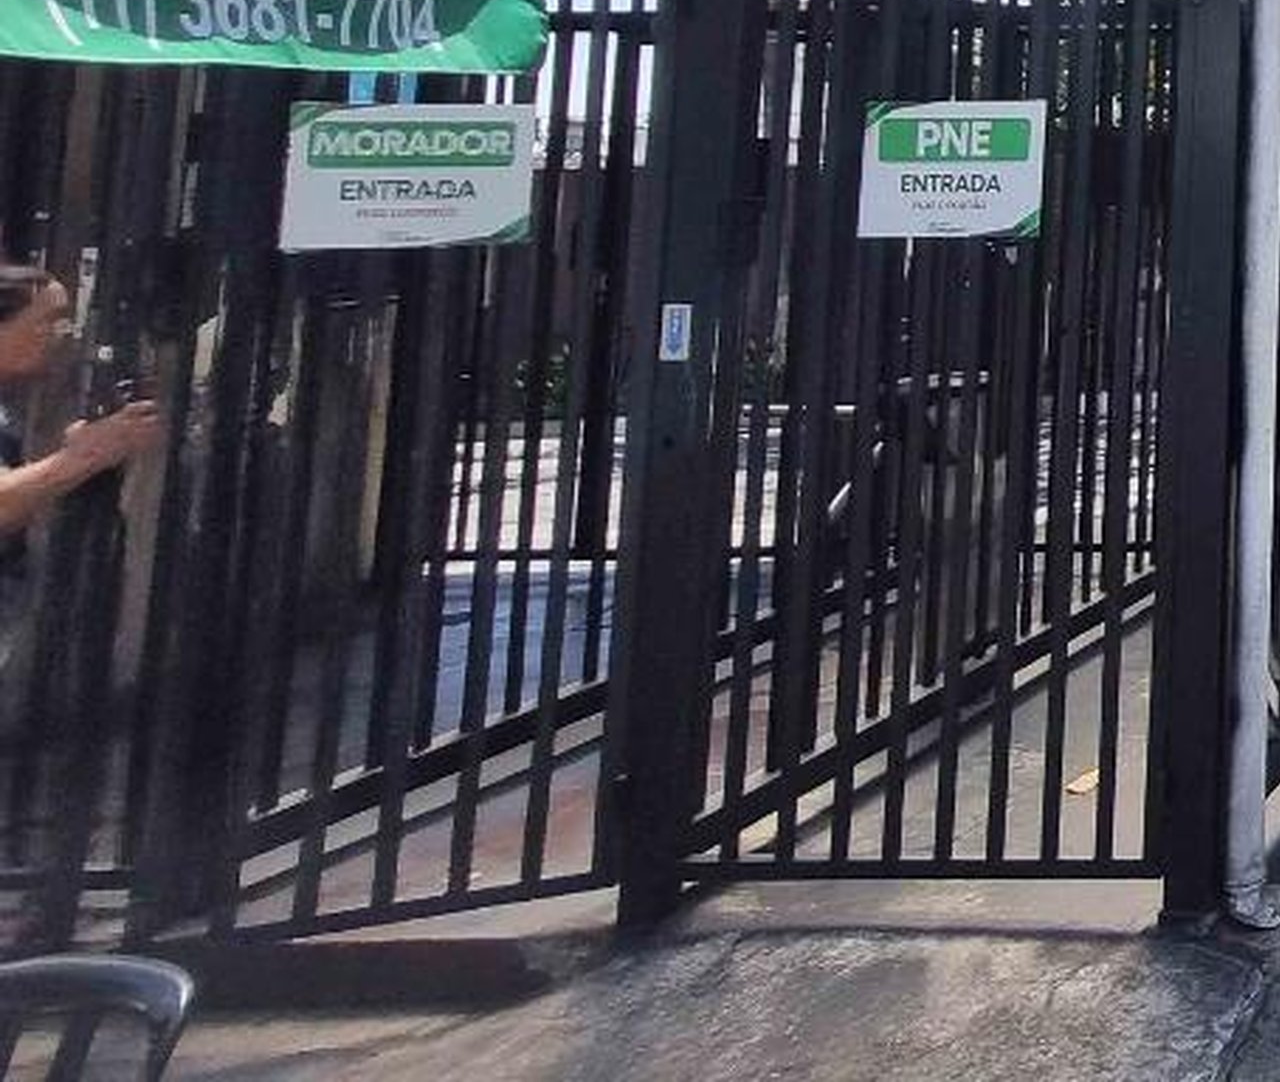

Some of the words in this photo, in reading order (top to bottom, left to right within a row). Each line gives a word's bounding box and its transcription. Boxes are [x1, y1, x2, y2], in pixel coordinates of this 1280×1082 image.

[310, 128, 513, 157] MORADOR
[916, 120, 993, 158] PNE
[339, 179, 477, 202] ENTRADA
[899, 174, 1002, 194] ENTRADA
